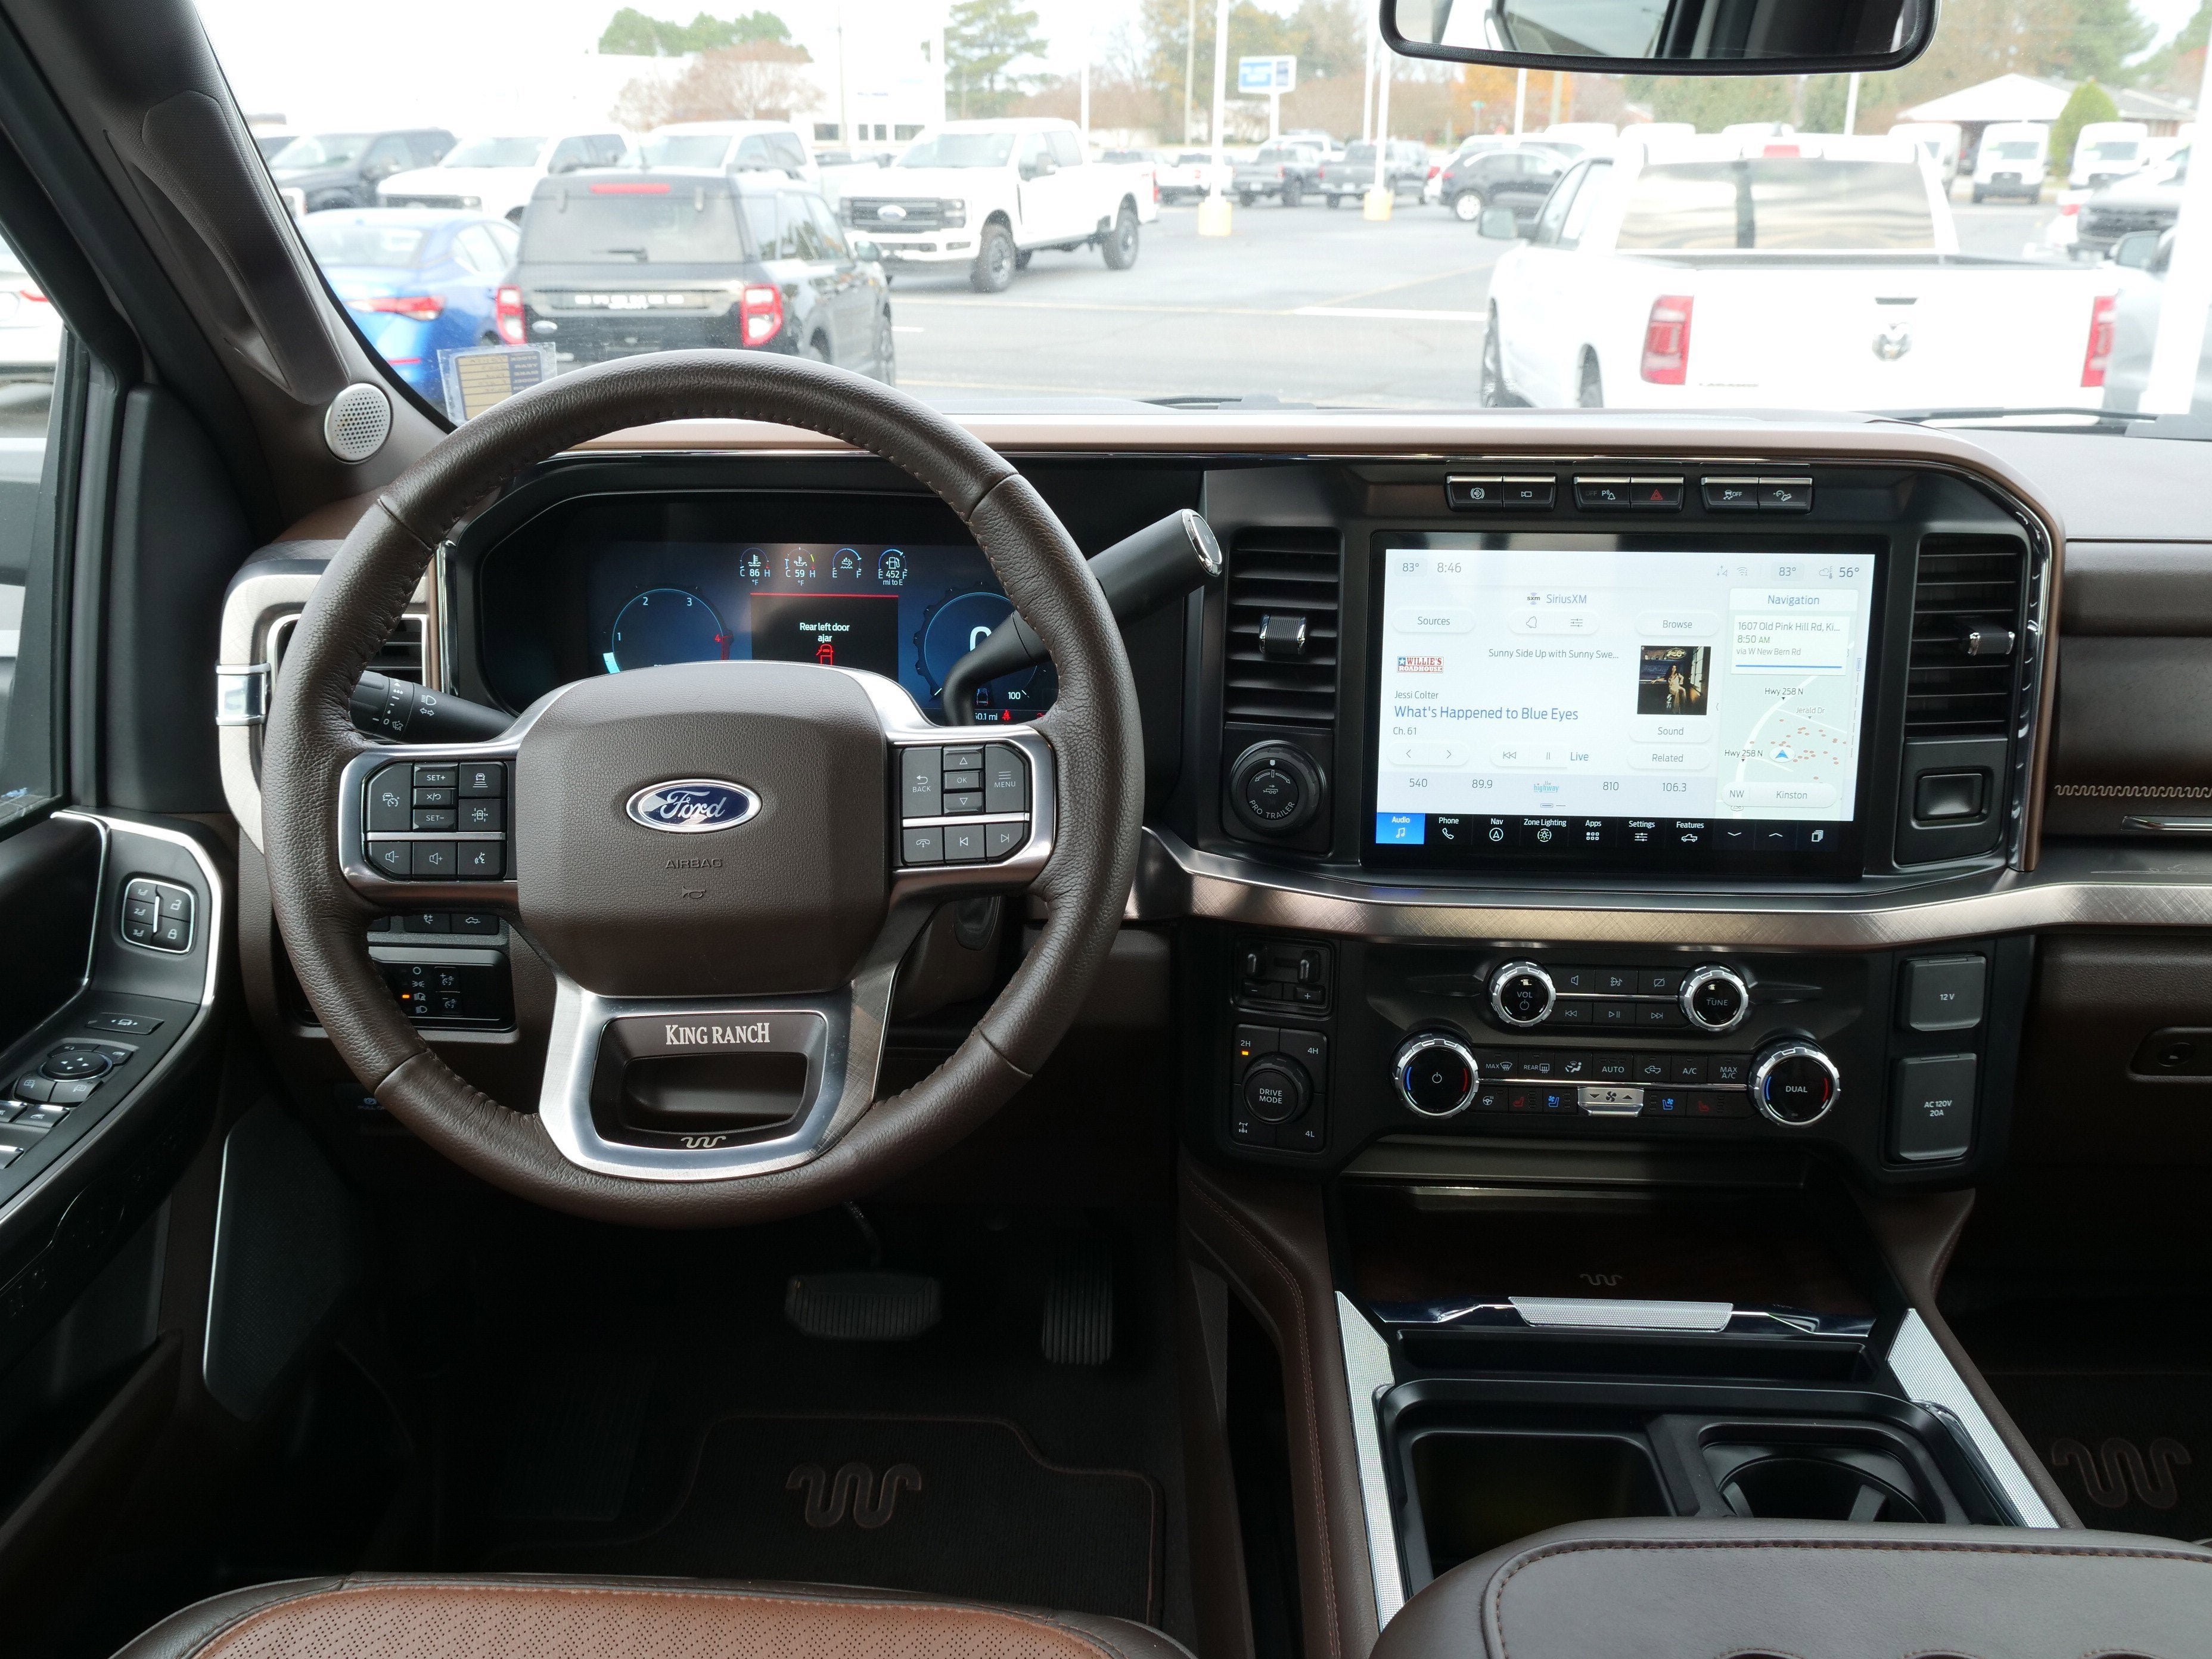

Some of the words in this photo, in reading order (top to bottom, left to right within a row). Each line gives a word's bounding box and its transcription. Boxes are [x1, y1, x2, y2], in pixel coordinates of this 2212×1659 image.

[1437, 563, 1461, 573] 8:46
[878, 570, 883, 579] E
[643, 597, 648, 605] 2
[687, 598, 692, 606] 3
[1546, 594, 1586, 604] SiriusXM
[1768, 595, 1819, 606] Navigation
[1418, 617, 1450, 625] Sources
[1759, 622, 1773, 630] Old
[617, 632, 620, 641] 1
[818, 634, 832, 643] ajar
[1489, 649, 1514, 658] Sunny
[1536, 650, 1546, 658] Up
[1569, 650, 1593, 659] Sunny
[1394, 706, 1436, 717] What's
[1440, 707, 1502, 720] Happened
[1506, 709, 1518, 719] to
[1522, 708, 1548, 719] Blue
[1552, 708, 1578, 722] Eyes
[1571, 752, 1589, 761] Live
[1725, 750, 1741, 758] Hwy
[1410, 778, 1427, 787] 540
[1472, 779, 1492, 788] 89.9
[1603, 782, 1618, 790] 810
[1663, 783, 1686, 791] 106.3
[1534, 784, 1559, 793] highway
[660, 790, 727, 819] Ford
[1250, 800, 1262, 814] PRO
[1266, 802, 1294, 818] TRAILER
[1541, 818, 1567, 827] Lighting
[666, 858, 722, 869] AIRBAG
[666, 1025, 708, 1045] KING
[712, 1023, 770, 1043] RANCH
[1260, 1089, 1282, 1098] DRIVE
